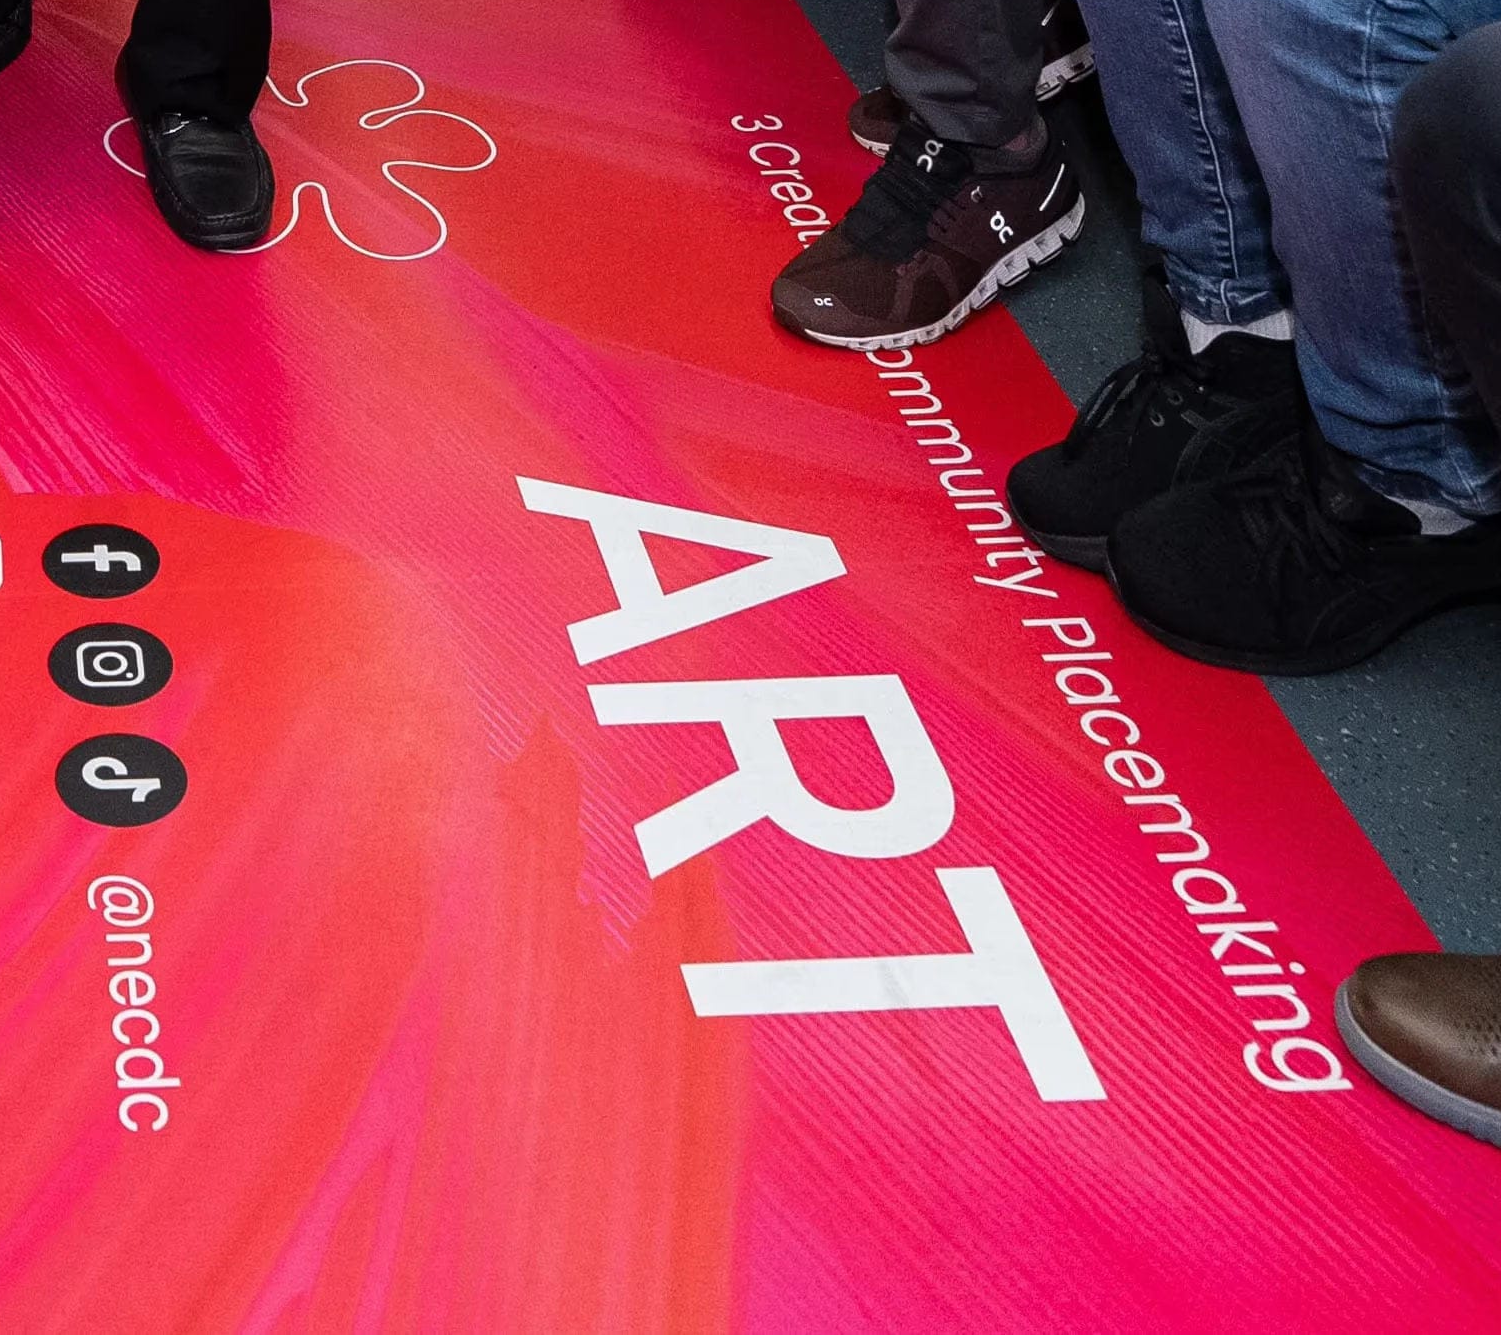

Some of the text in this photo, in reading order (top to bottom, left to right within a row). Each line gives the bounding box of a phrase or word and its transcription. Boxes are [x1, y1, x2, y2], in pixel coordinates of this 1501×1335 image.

[731, 113, 784, 133] 3
[513, 474, 1108, 1102] ART
[865, 349, 1354, 1093] ommunity Placemaking
[87, 874, 182, 1133] @necdc
